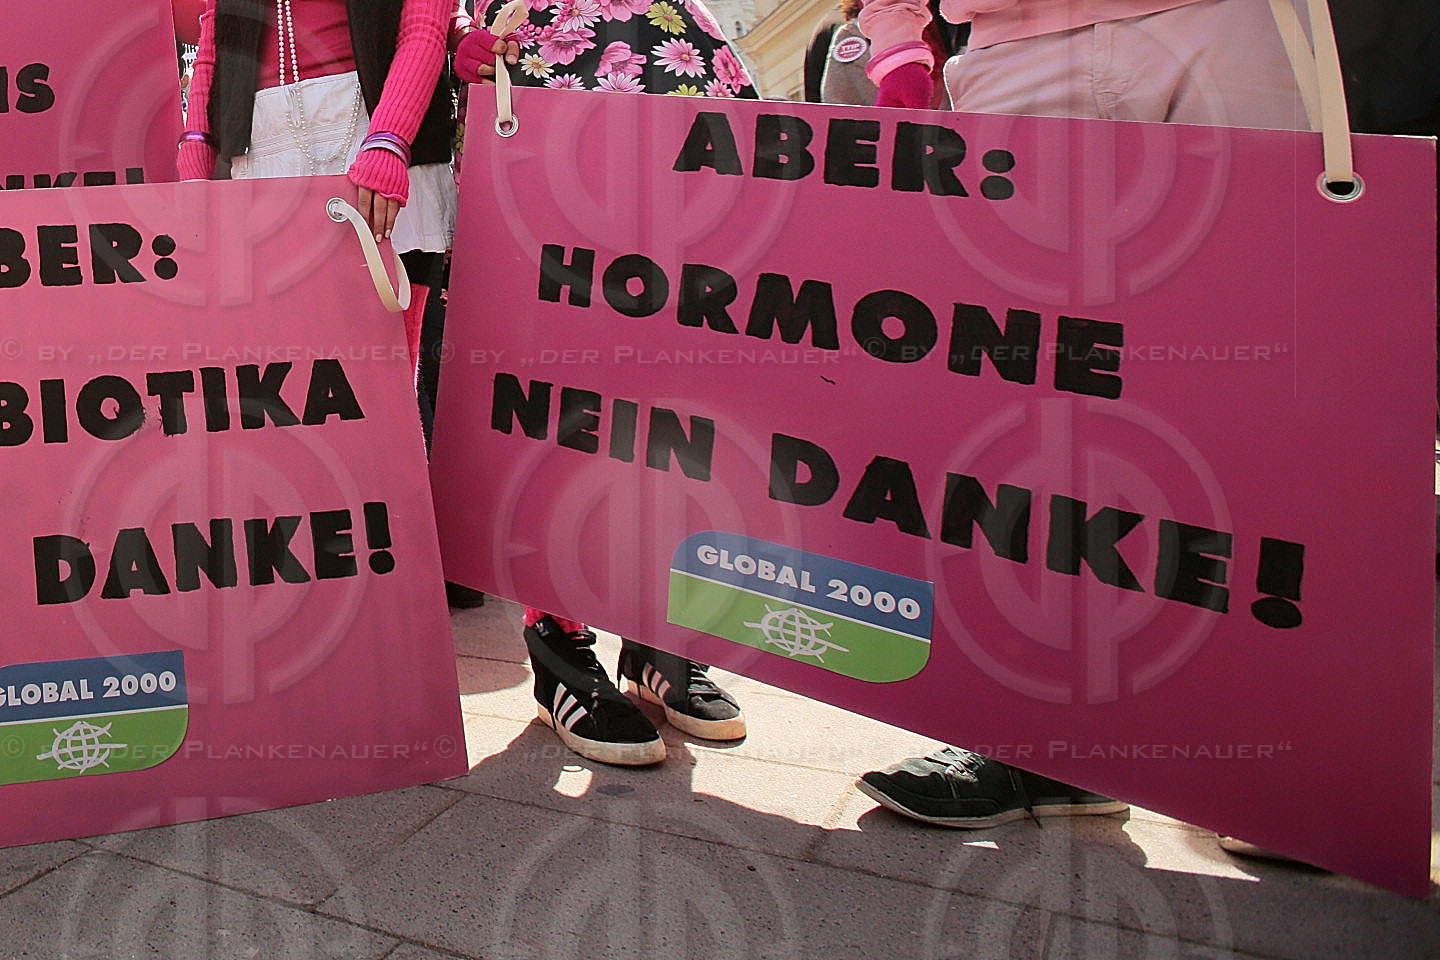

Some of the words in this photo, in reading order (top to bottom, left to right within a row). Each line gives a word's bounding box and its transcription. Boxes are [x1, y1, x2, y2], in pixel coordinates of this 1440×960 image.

[673, 112, 1015, 200] ABER:
[537, 244, 1124, 399] HORMONE
[491, 373, 714, 481] NEIN
[769, 433, 1306, 630] DANKE!
[34, 502, 395, 605] DANKE!
[696, 545, 816, 593] GLOBAL
[825, 579, 921, 620] 2000
[103, 671, 177, 698] 2000
